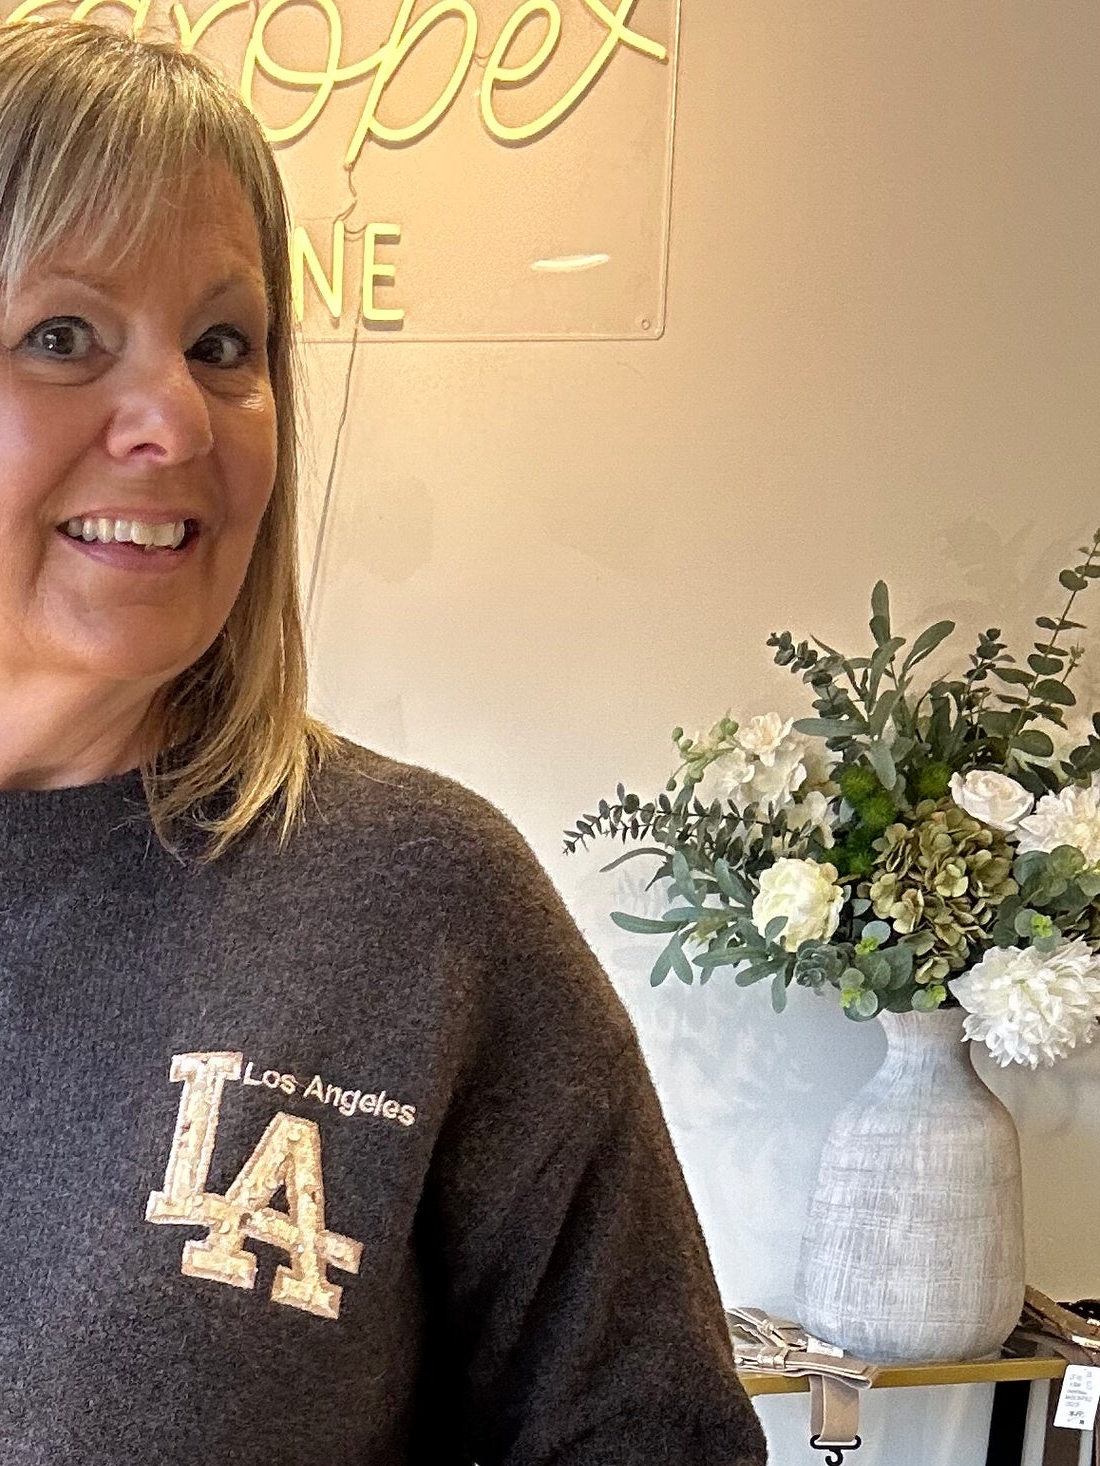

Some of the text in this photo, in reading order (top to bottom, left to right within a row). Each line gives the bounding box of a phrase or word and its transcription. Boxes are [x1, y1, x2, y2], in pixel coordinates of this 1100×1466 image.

[243, 1061, 418, 1127] Los Angeles
[145, 1050, 365, 1321] LA
